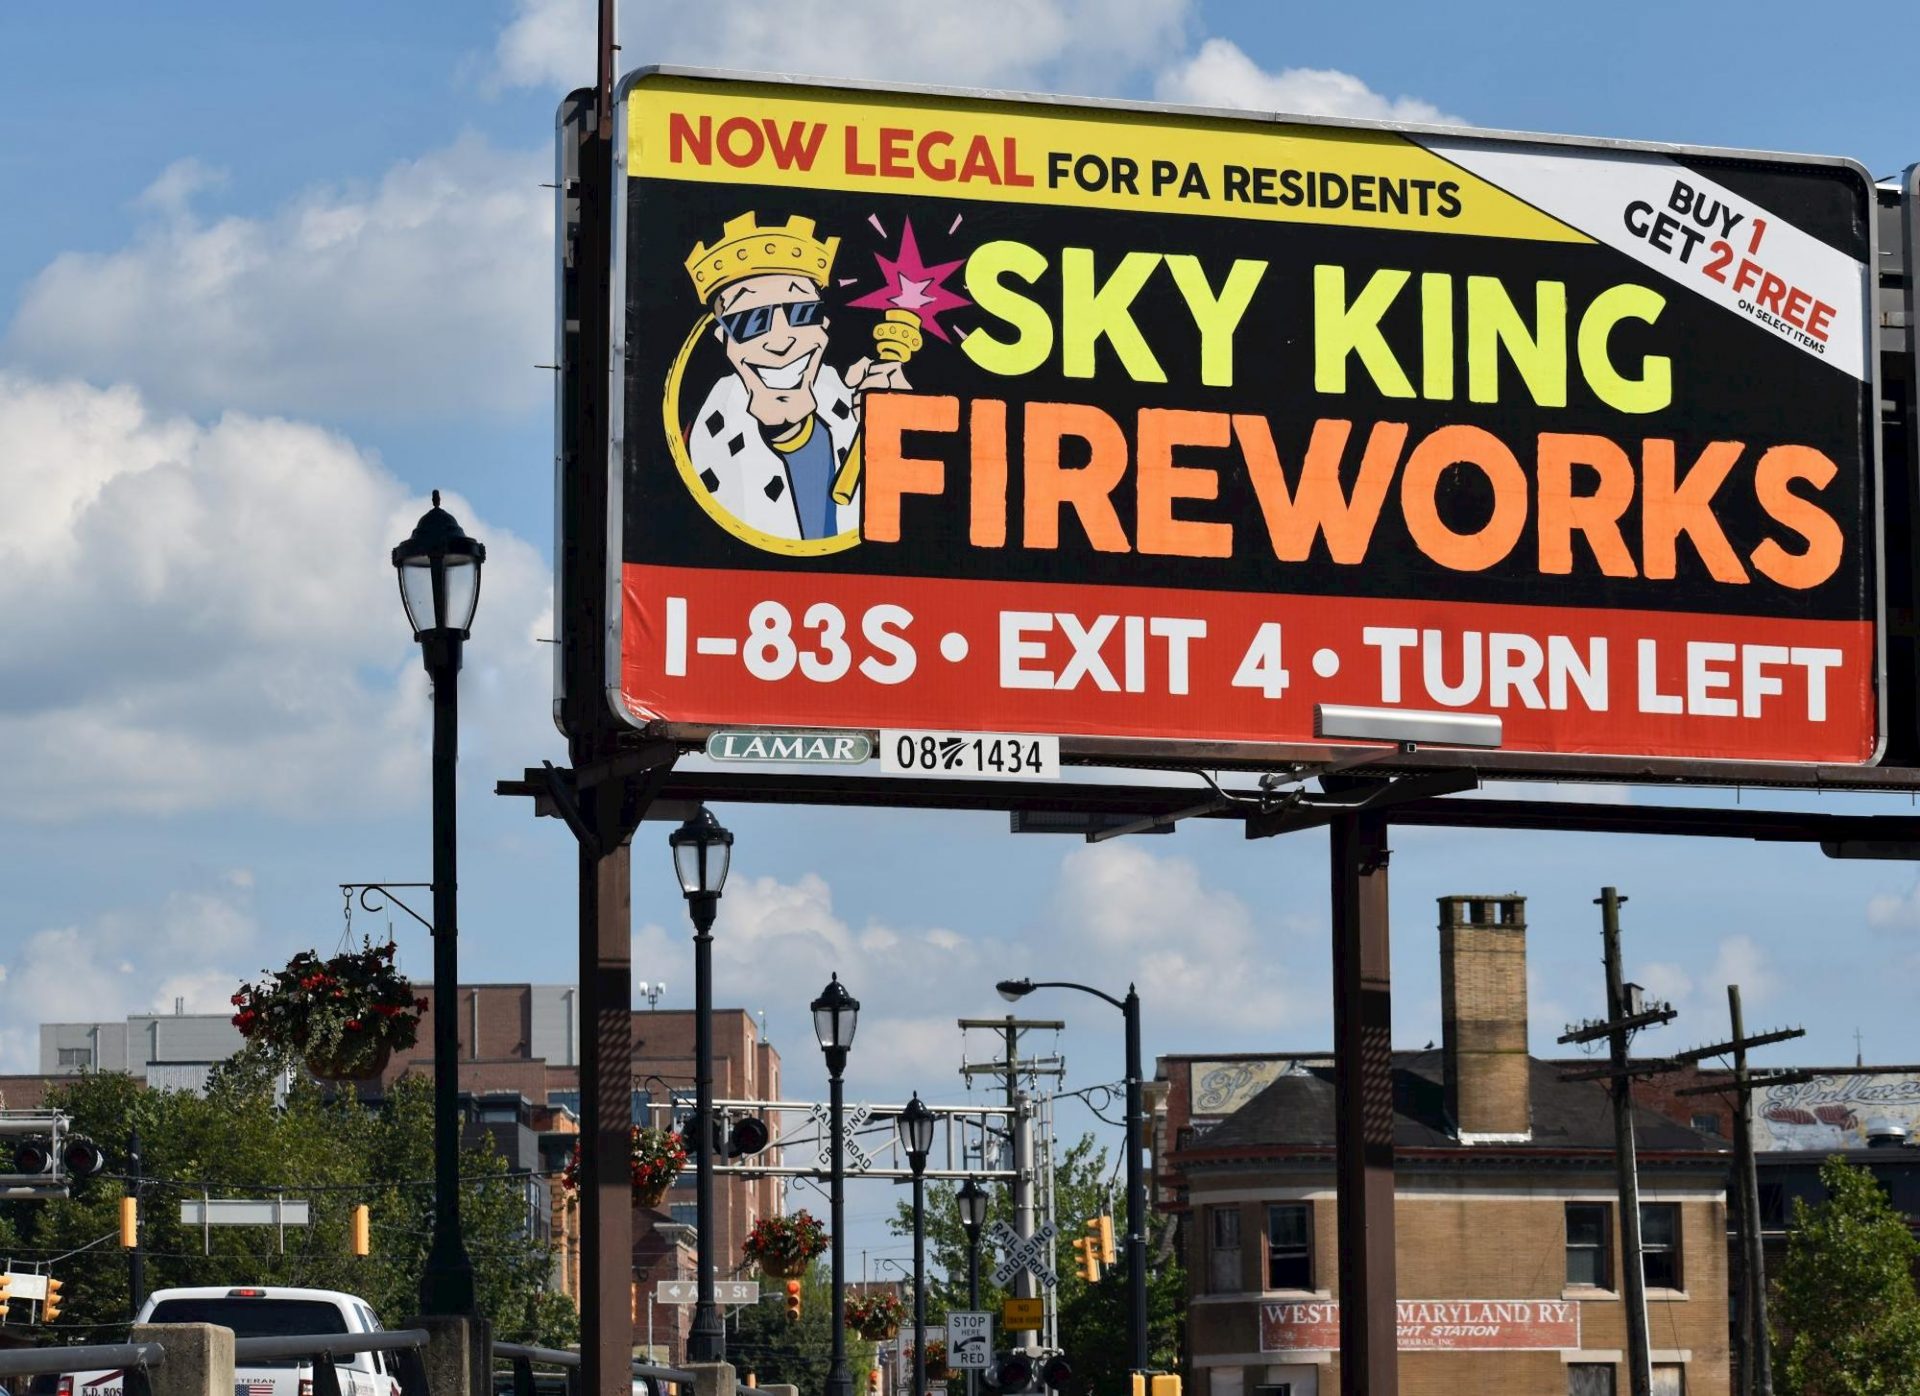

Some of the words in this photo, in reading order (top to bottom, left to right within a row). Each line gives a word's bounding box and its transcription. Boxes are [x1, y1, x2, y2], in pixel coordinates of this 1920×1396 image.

[669, 112, 827, 172] NOW
[844, 125, 1035, 188] LEGAL
[1048, 151, 1140, 195] FOR
[1152, 159, 1211, 200] PA
[1223, 164, 1463, 219] RESIDENTS
[1668, 180, 1745, 239] BUY
[1748, 218, 1767, 255] 1
[1623, 200, 1705, 264] GET
[1702, 240, 1734, 284] 2
[1732, 258, 1837, 343] FREE
[960, 240, 1269, 387] SKY
[1313, 264, 1671, 414] KING
[1738, 299, 1755, 314] ON
[1756, 310, 1793, 335] SELECT
[1793, 331, 1825, 354] ITEMS
[863, 393, 1844, 590] FIREWORKS
[999, 610, 1207, 695] EXIT
[1231, 622, 1290, 699] 4
[1362, 625, 1608, 711] TURN
[1637, 638, 1843, 722] LEFT
[723, 736, 855, 760] LAMAR
[897, 735, 937, 770] 08
[972, 739, 1043, 773] 1434
[993, 1222, 1017, 1252] RAIL
[1027, 1258, 1056, 1288] ROAD
[996, 1226, 1053, 1282] CROSSING
[688, 1285, 722, 1298] Ah
[732, 1285, 748, 1298] St
[1266, 1303, 1340, 1324] WEST
[1397, 1303, 1531, 1323] MARYLAND
[1539, 1303, 1574, 1323] RY.
[953, 1317, 986, 1328] STOP
[1430, 1325, 1500, 1336] STATION
[961, 1353, 984, 1364] RED
